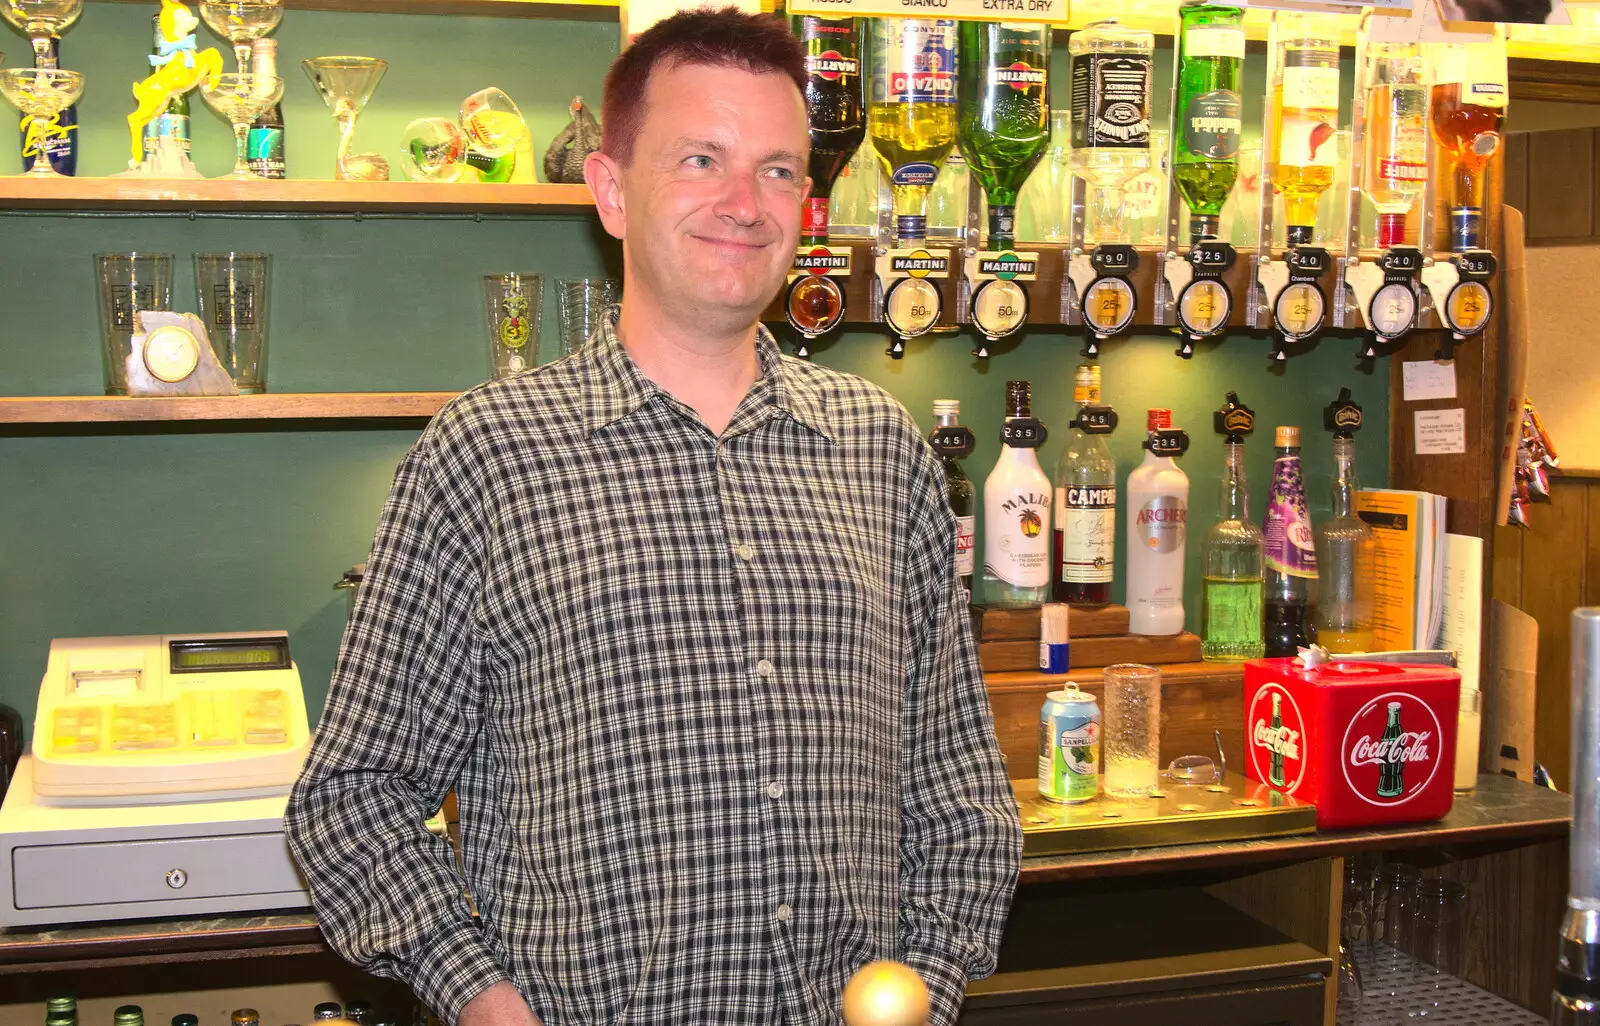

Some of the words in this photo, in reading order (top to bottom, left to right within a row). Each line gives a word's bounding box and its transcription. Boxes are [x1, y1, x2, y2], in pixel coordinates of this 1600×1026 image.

[982, 0, 1024, 10] EXTRA
[1028, 0, 1051, 11] DRY
[894, 77, 952, 92] CINZAO
[796, 256, 846, 267] MARTINI
[895, 259, 945, 270] MARTINI
[983, 261, 1033, 273] MARTINI
[1001, 492, 1050, 514] MALIB
[1254, 718, 1299, 760] Coca-Cola
[1351, 731, 1431, 766] Coca-Cola
